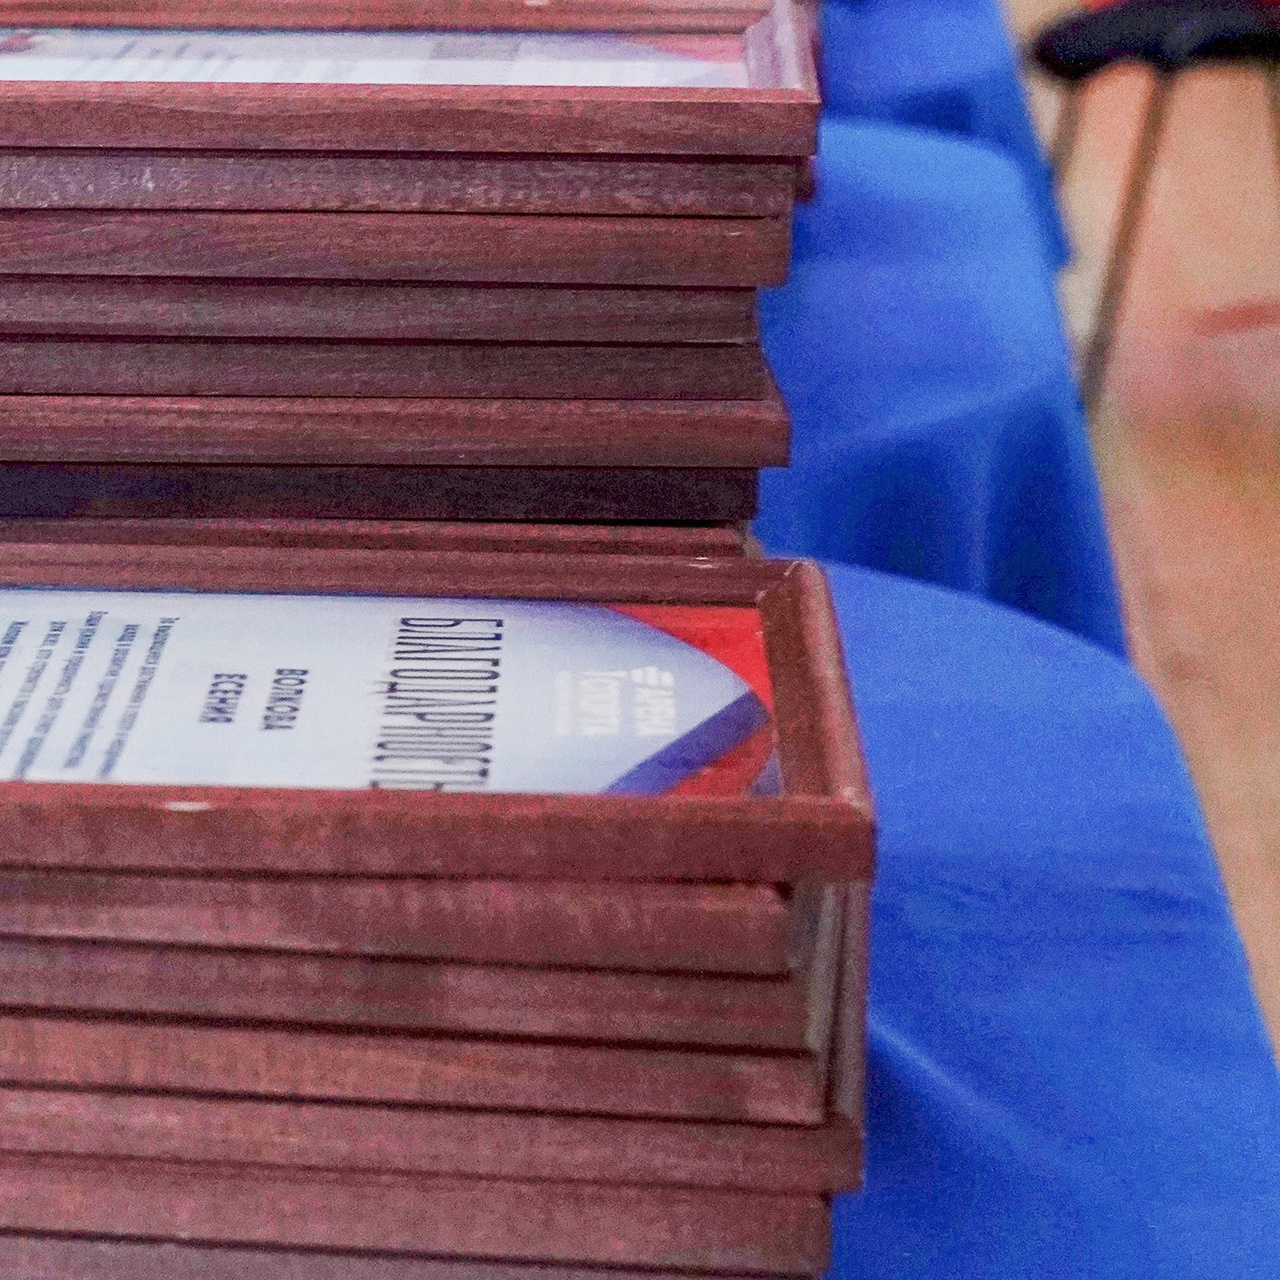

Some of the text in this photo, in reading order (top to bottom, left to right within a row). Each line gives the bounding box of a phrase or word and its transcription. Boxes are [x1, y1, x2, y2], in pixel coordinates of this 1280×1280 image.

[199, 673, 248, 723] ЕСЕНИЯ
[262, 668, 308, 730] ВОЛКОВА
[370, 617, 504, 790] БЛАГОДАРНОСТЬ
